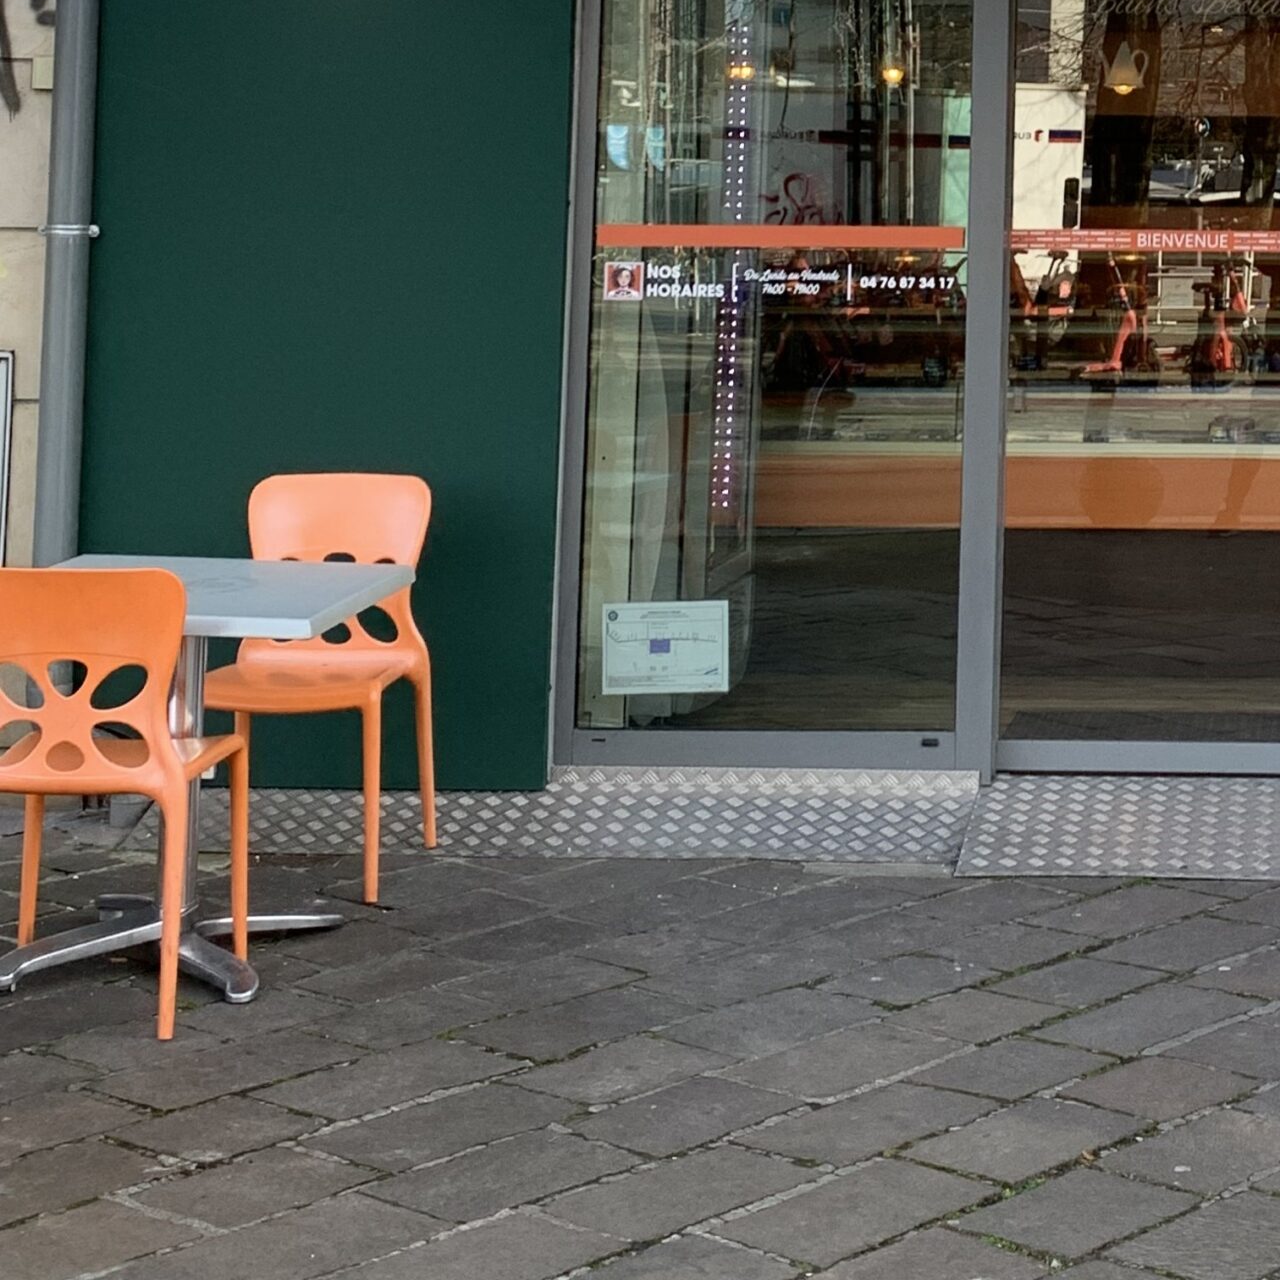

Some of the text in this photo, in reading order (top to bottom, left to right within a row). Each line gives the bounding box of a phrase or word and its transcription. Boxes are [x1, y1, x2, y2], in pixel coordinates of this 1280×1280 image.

[1137, 233, 1228, 248] BIENVENUE
[647, 263, 681, 279] NOS
[860, 276, 877, 289] 04
[880, 276, 897, 289] 76
[919, 276, 936, 289] 34
[938, 276, 955, 289] 17
[646, 283, 725, 298] HORAIRES
